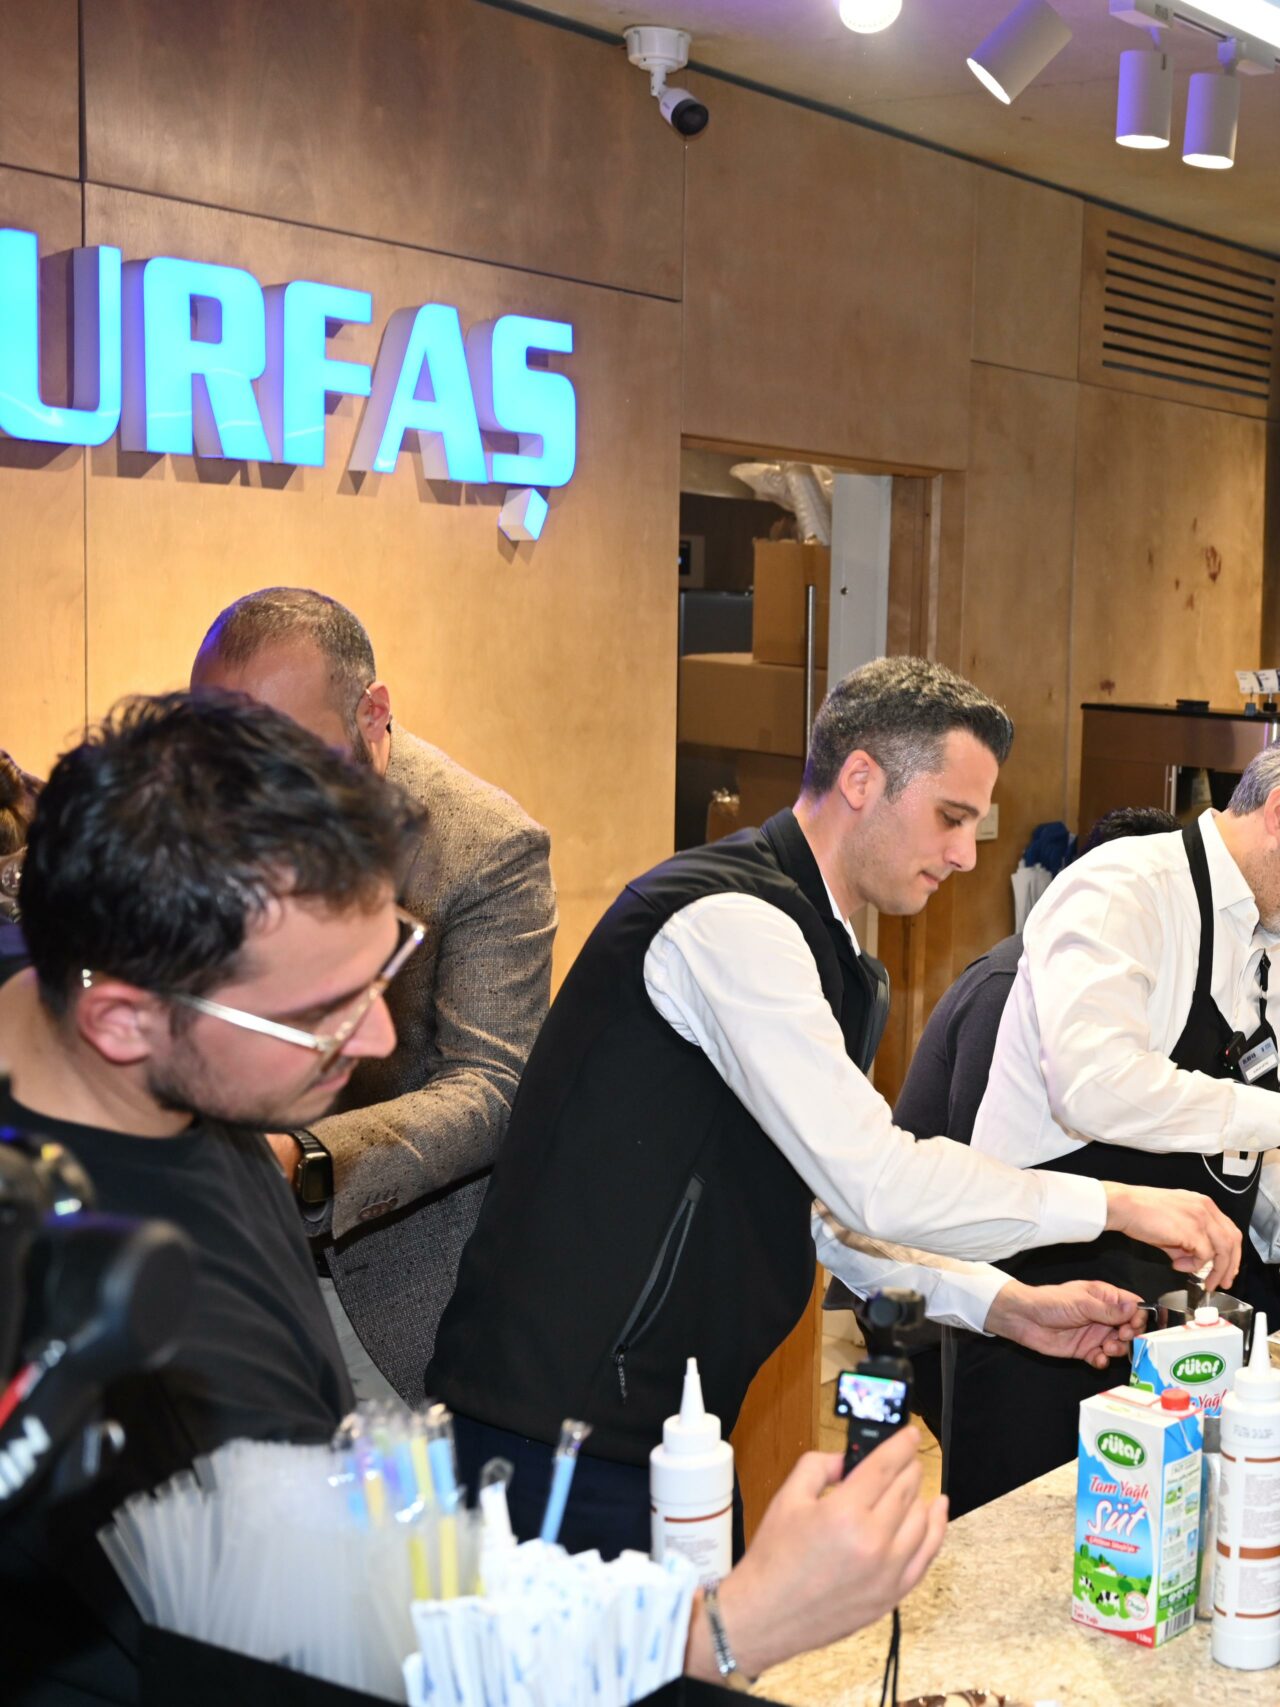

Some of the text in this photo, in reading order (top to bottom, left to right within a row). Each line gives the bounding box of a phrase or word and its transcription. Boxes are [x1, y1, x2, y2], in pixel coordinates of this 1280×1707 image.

[1090, 1475, 1149, 1504] Tam Yağlı
[1087, 1499, 1147, 1537] Süt
